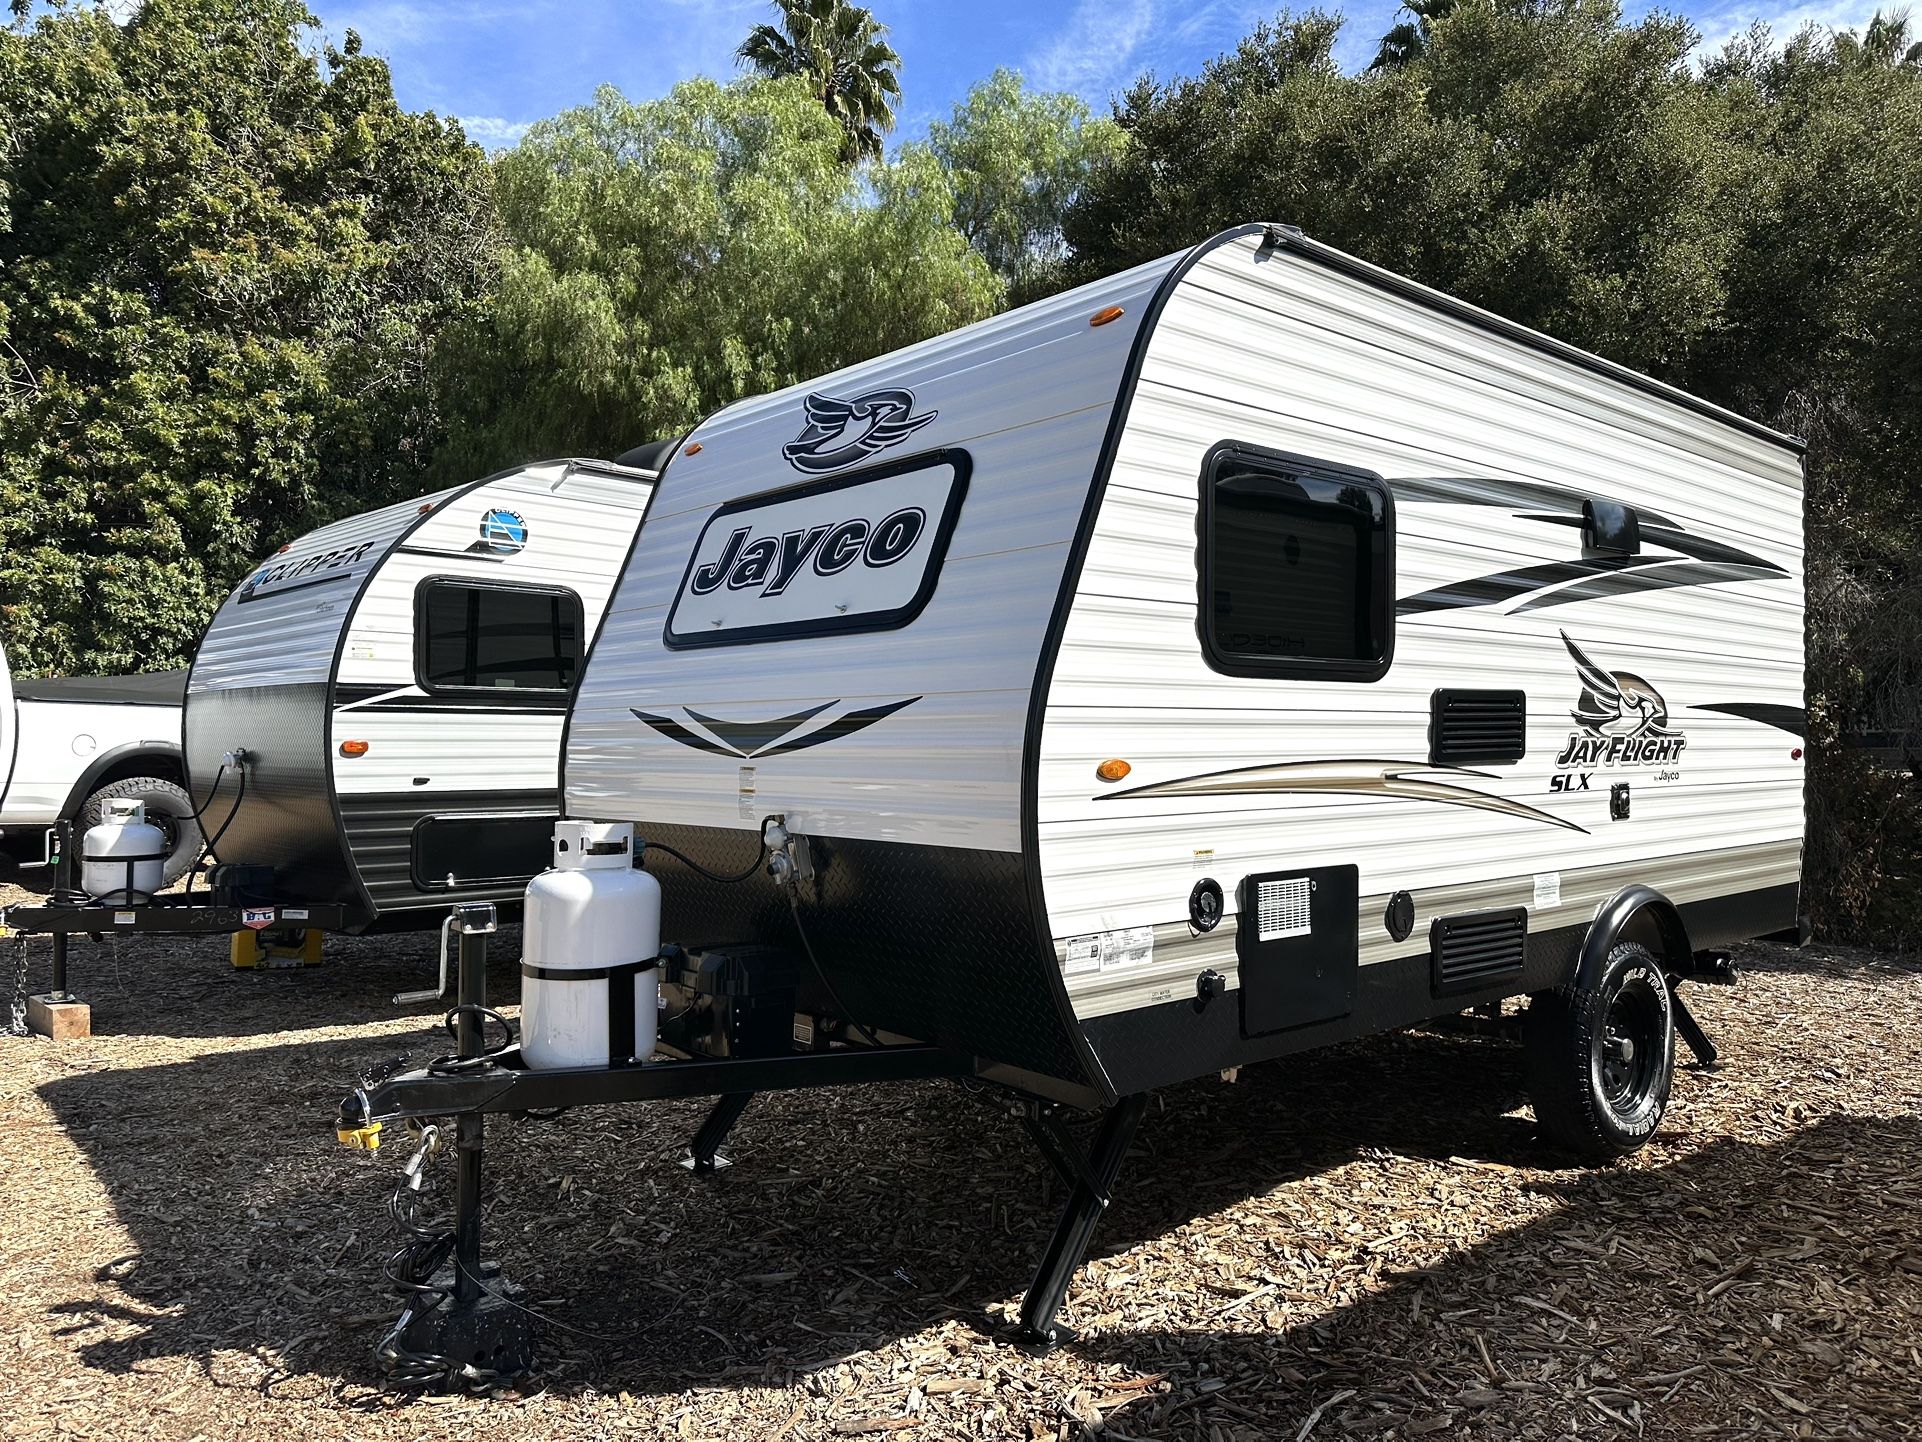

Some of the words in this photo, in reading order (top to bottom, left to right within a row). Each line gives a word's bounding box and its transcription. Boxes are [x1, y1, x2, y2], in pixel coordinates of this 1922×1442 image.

[262, 541, 375, 585] CLIPPER
[691, 506, 926, 598] Jayco
[1556, 733, 1606, 768] JAY
[1604, 733, 1686, 767] FLIGHT
[1549, 773, 1593, 793] SLX
[1658, 769, 1680, 783] Jayco
[190, 908, 239, 926] 2963
[1626, 1101, 1661, 1136] RADIAL
